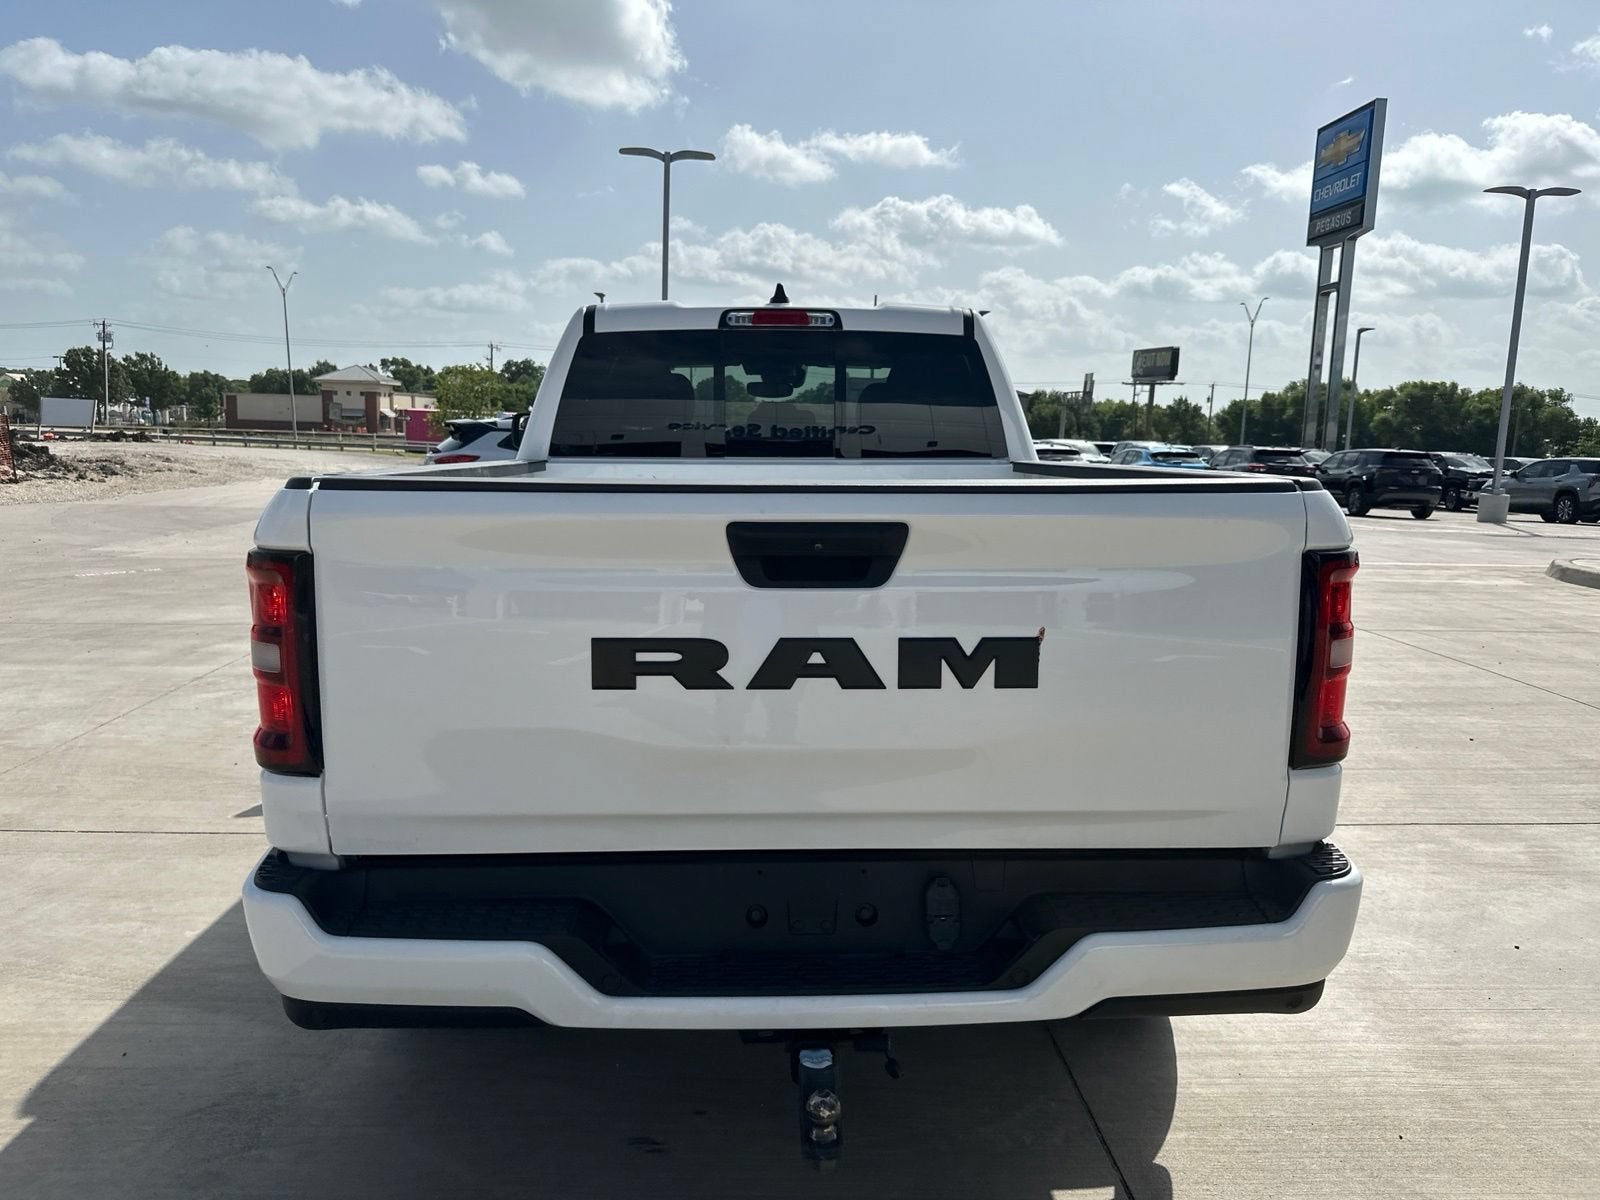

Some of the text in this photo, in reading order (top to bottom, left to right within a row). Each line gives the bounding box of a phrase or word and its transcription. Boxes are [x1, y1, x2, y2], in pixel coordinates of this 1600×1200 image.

[1313, 172, 1362, 202] CHEVROLET
[1315, 209, 1352, 233] PEGASUS
[591, 637, 1040, 690] RAM
